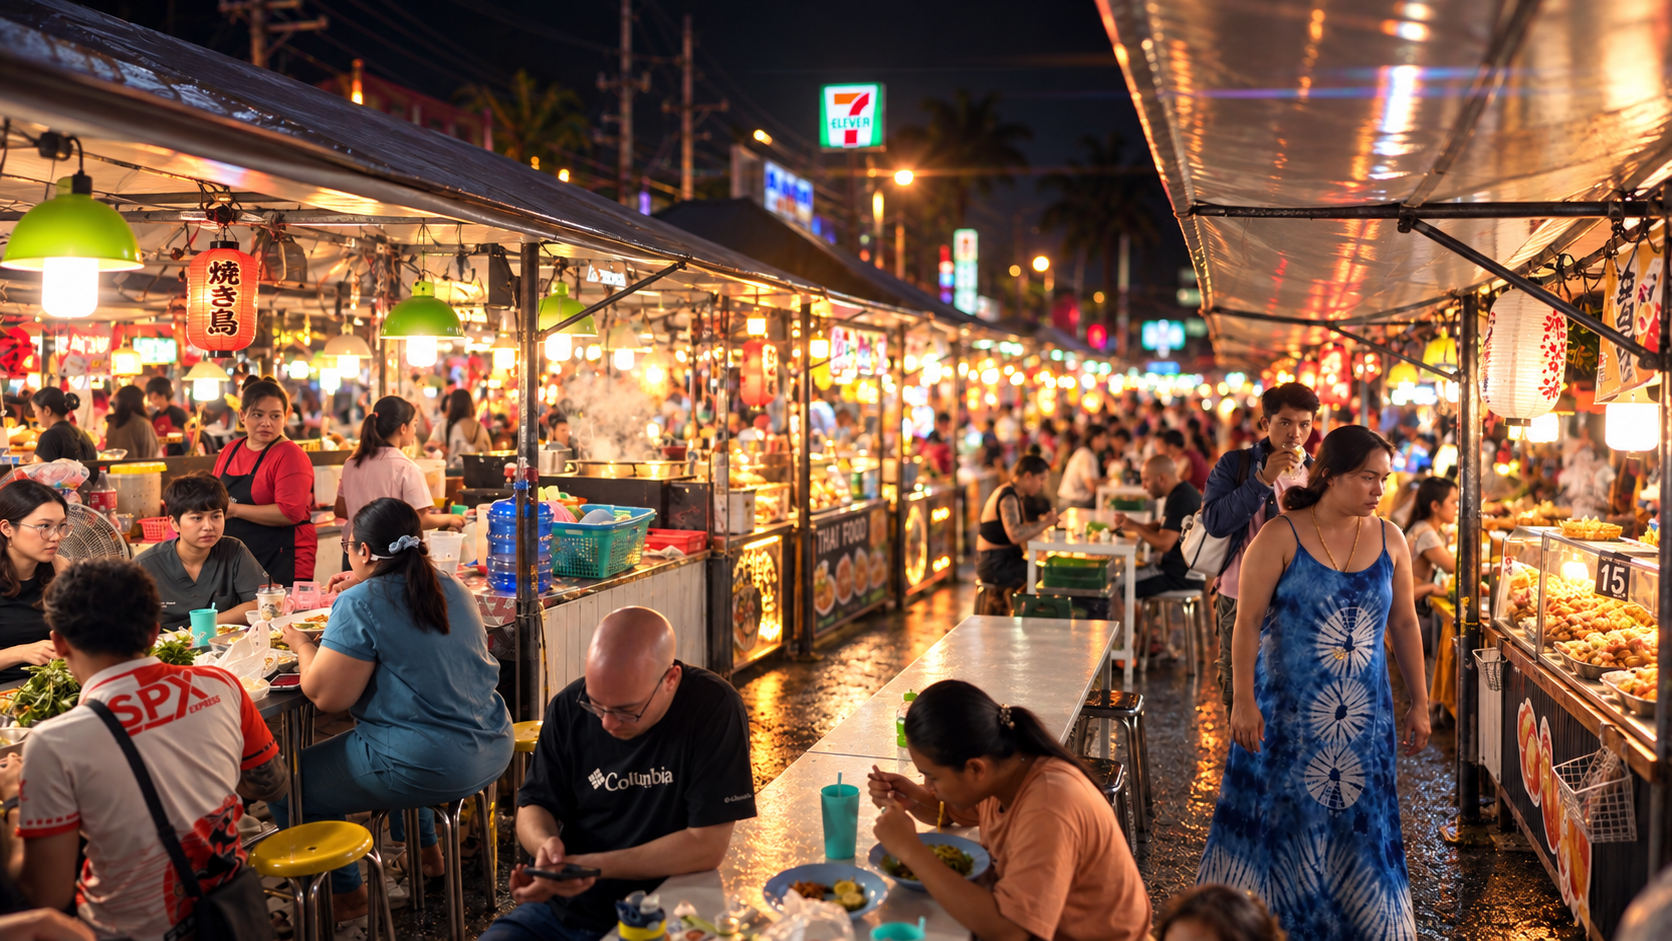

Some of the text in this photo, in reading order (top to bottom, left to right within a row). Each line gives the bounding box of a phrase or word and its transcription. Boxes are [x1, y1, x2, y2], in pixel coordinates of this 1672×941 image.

[834, 92, 870, 144] 7
[208, 260, 240, 336] 焼き鳥
[817, 516, 867, 554] THAI FOOD
[1601, 564, 1625, 594] 15
[107, 669, 221, 730] SPX EXPRESS
